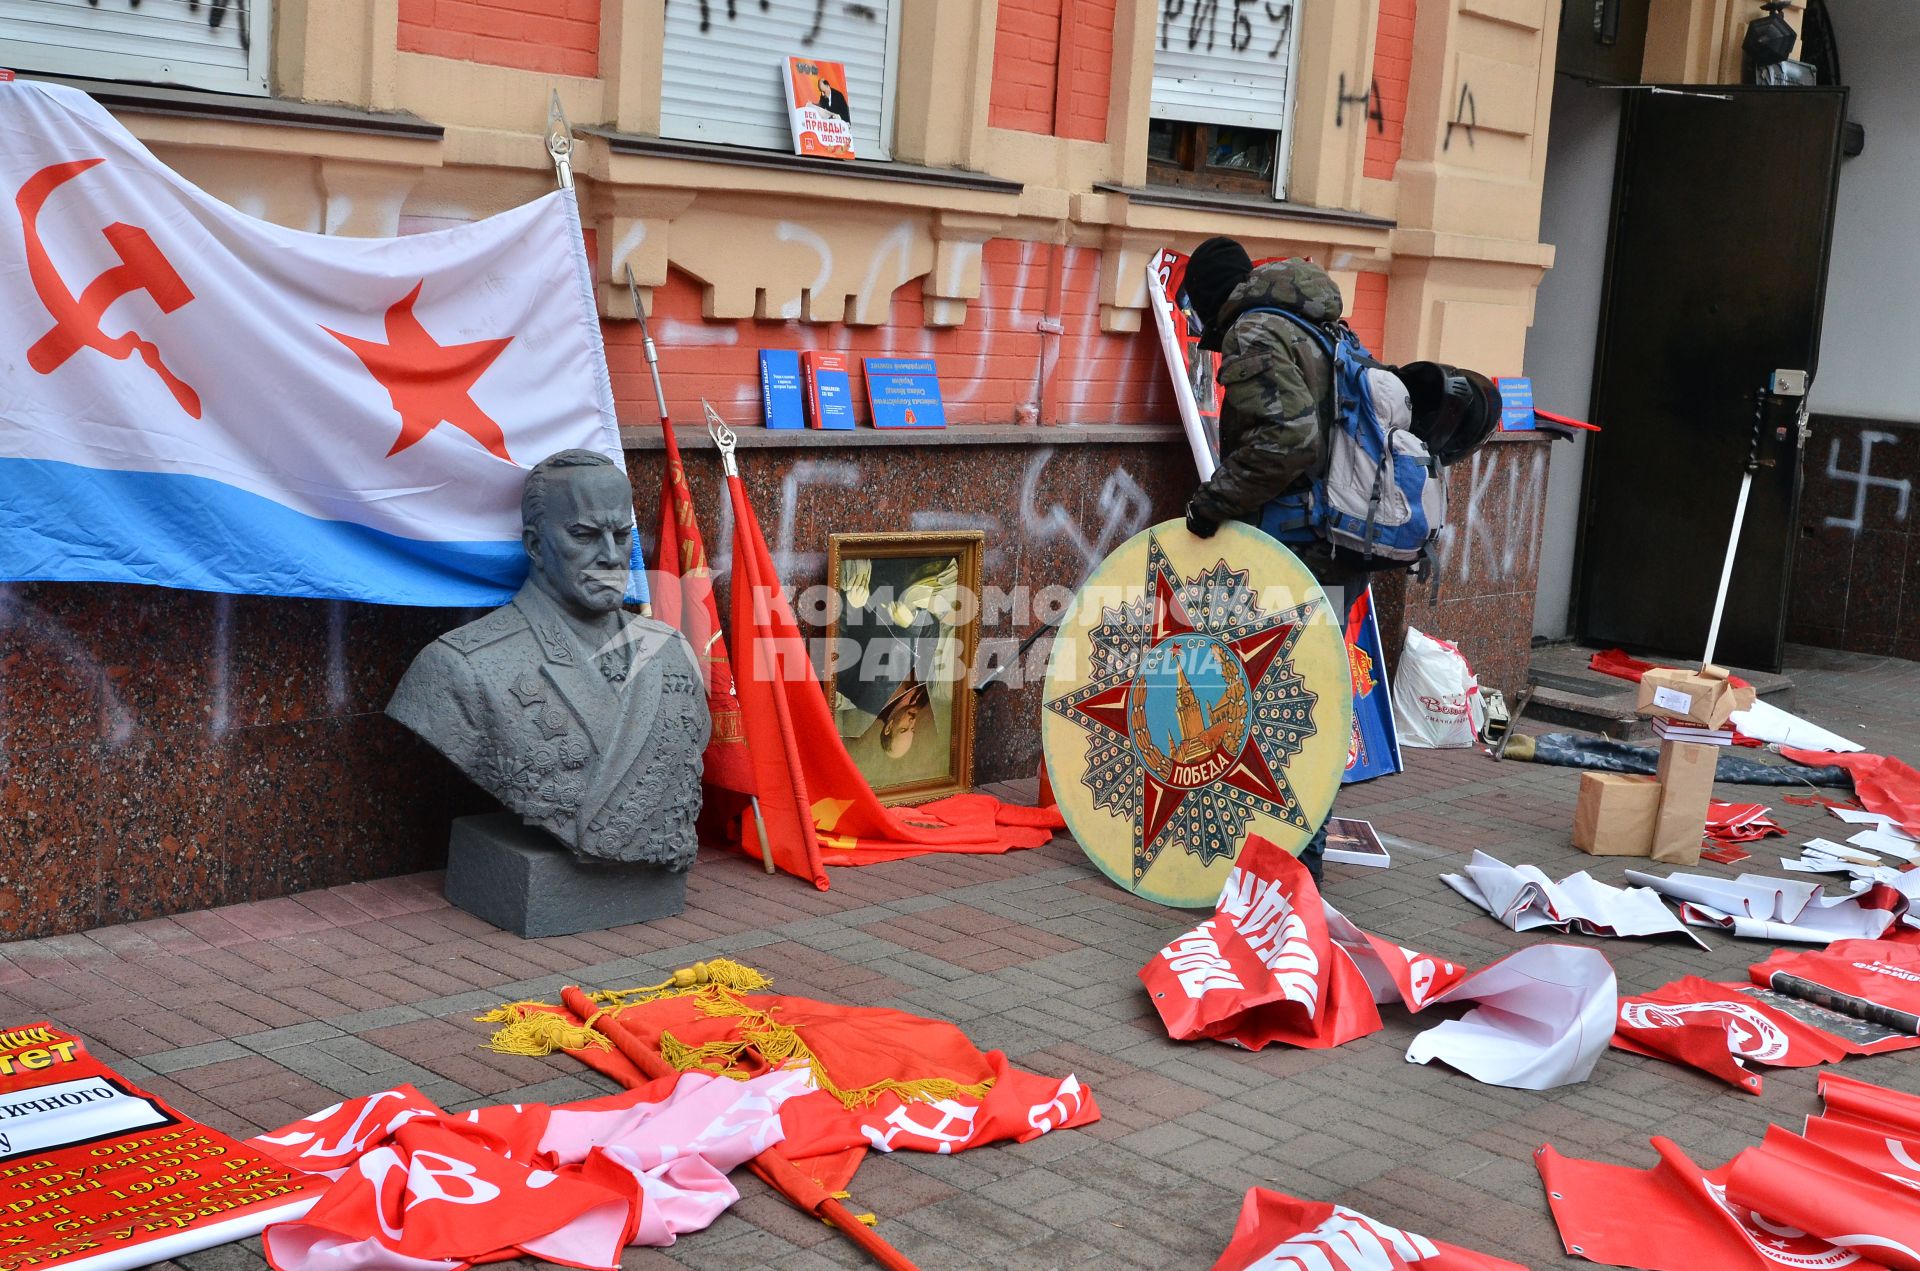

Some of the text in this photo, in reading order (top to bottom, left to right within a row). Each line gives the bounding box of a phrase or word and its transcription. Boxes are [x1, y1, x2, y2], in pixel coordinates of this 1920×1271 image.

[1173, 753, 1230, 786] ПОБЕДА
[0, 1040, 75, 1075] тет
[89, 1127, 197, 1158] орга-
[139, 1146, 227, 1175] 1919
[107, 1168, 201, 1201] 1993
[221, 1157, 262, 1171] р.
[107, 1185, 305, 1240] України.
